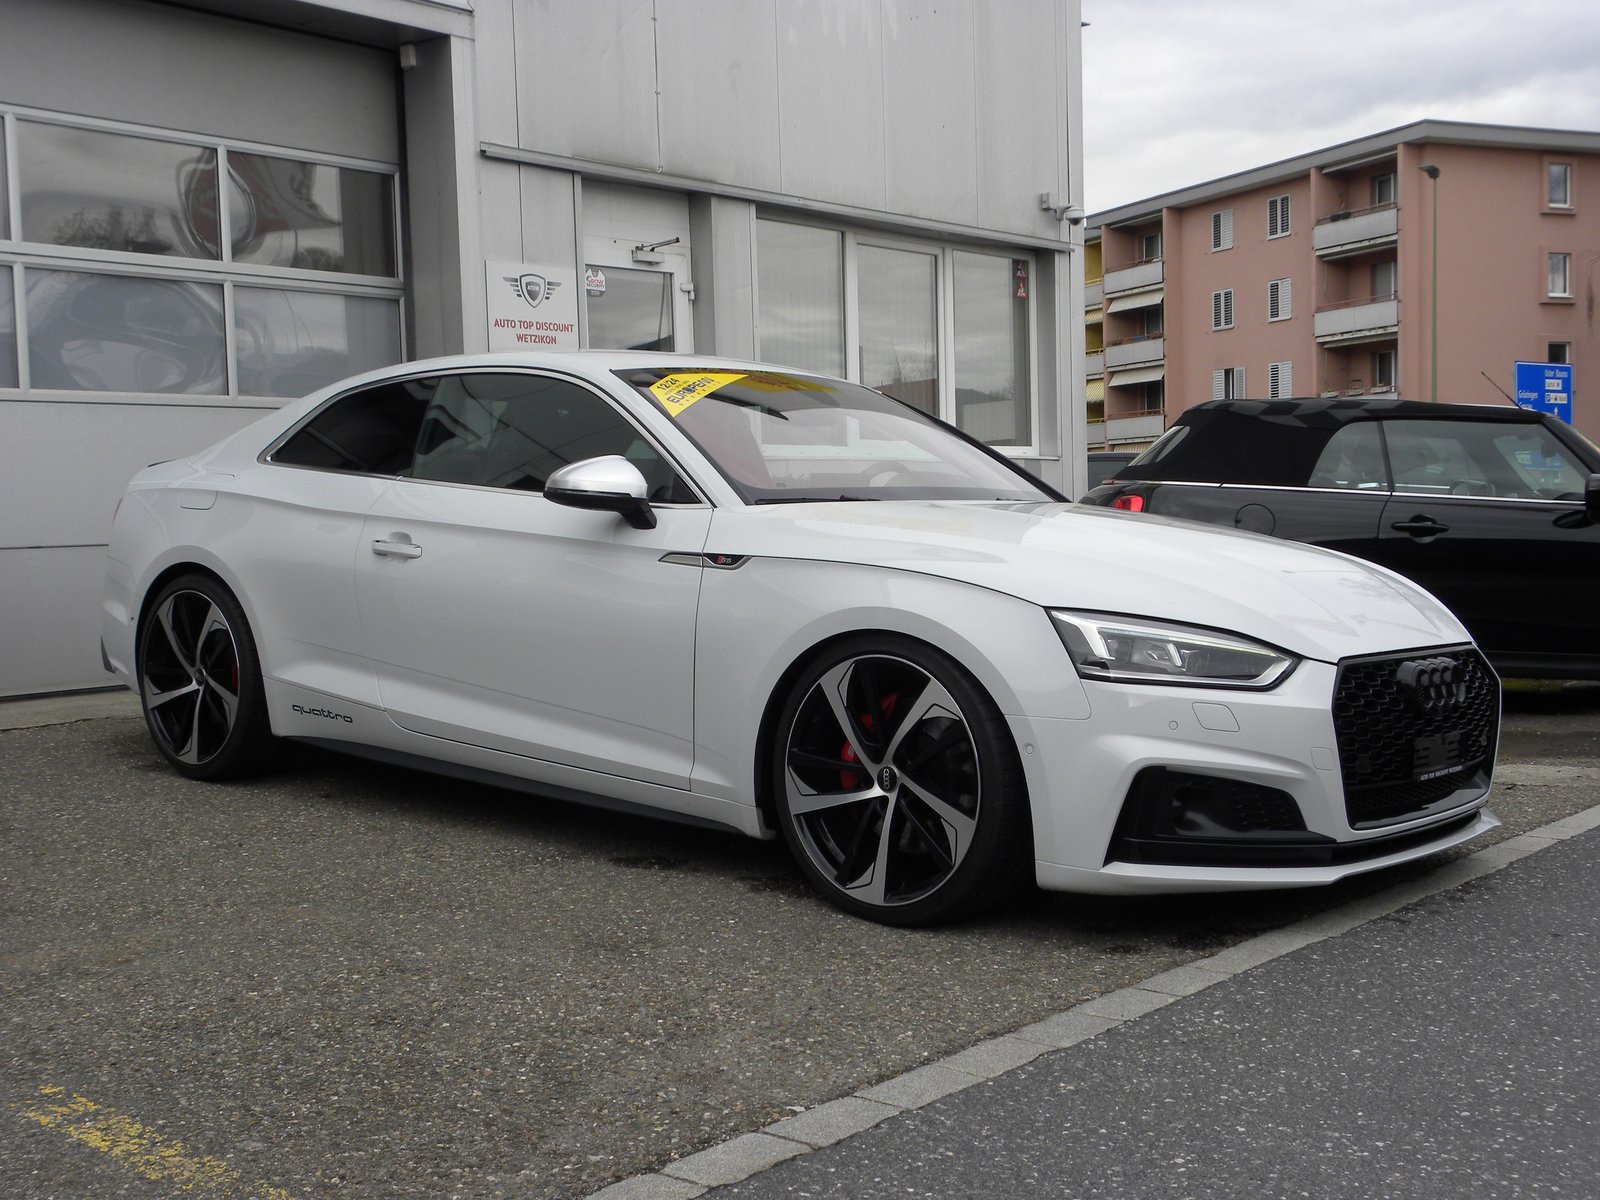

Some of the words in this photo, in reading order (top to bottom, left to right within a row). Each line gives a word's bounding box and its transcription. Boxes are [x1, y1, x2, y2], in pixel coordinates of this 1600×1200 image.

[494, 319, 516, 329] AUTO
[518, 320, 534, 330] TOP
[536, 322, 574, 333] DISCOUNT
[516, 333, 557, 345] WETZIKON
[292, 705, 353, 723] quattro
